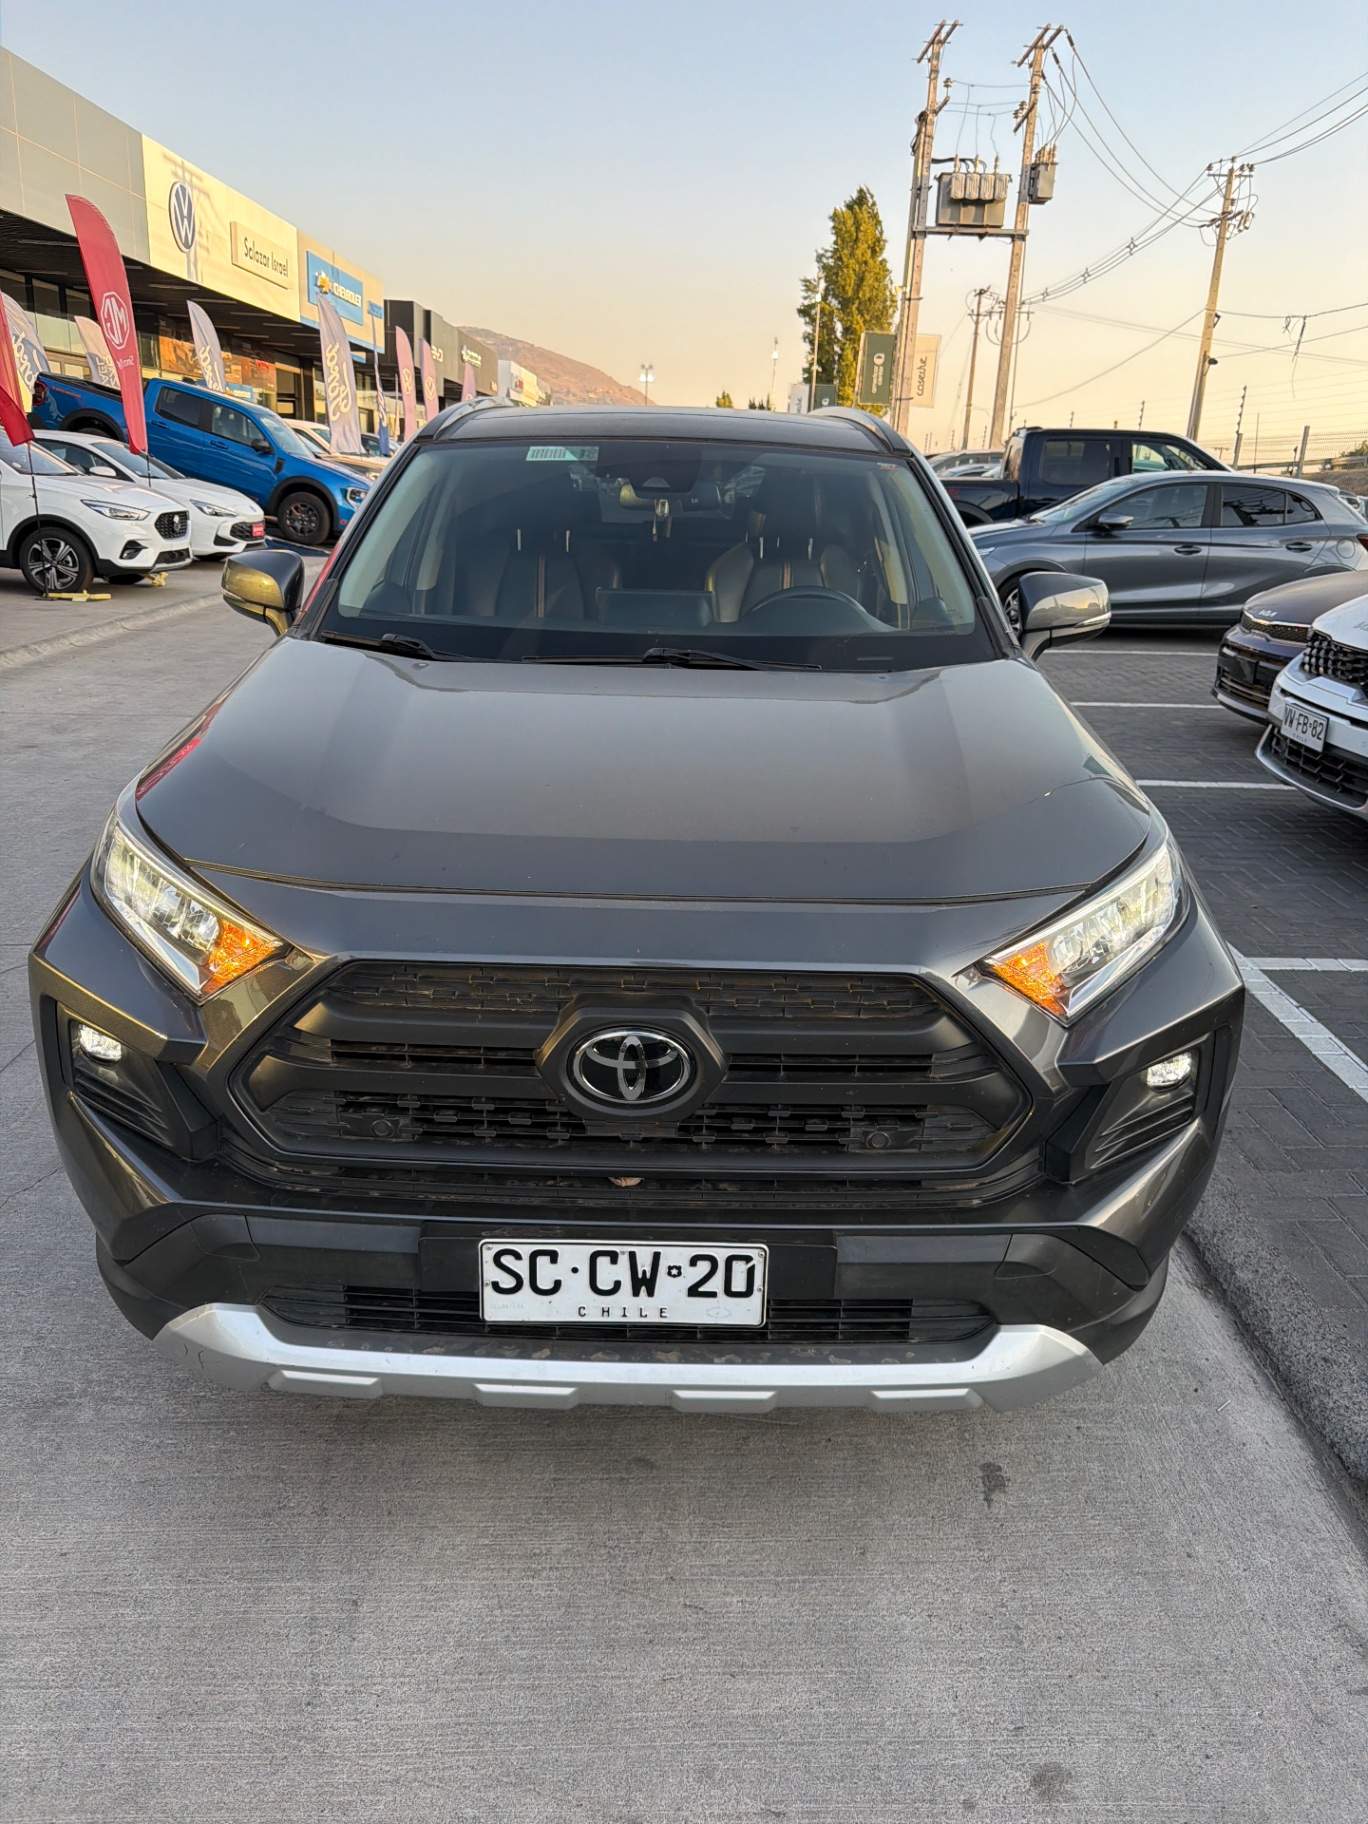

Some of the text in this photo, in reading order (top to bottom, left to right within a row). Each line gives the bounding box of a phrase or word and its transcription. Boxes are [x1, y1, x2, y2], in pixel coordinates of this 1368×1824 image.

[243, 236, 289, 277] Salazar Israel
[577, 1305, 668, 1319] CHILE
